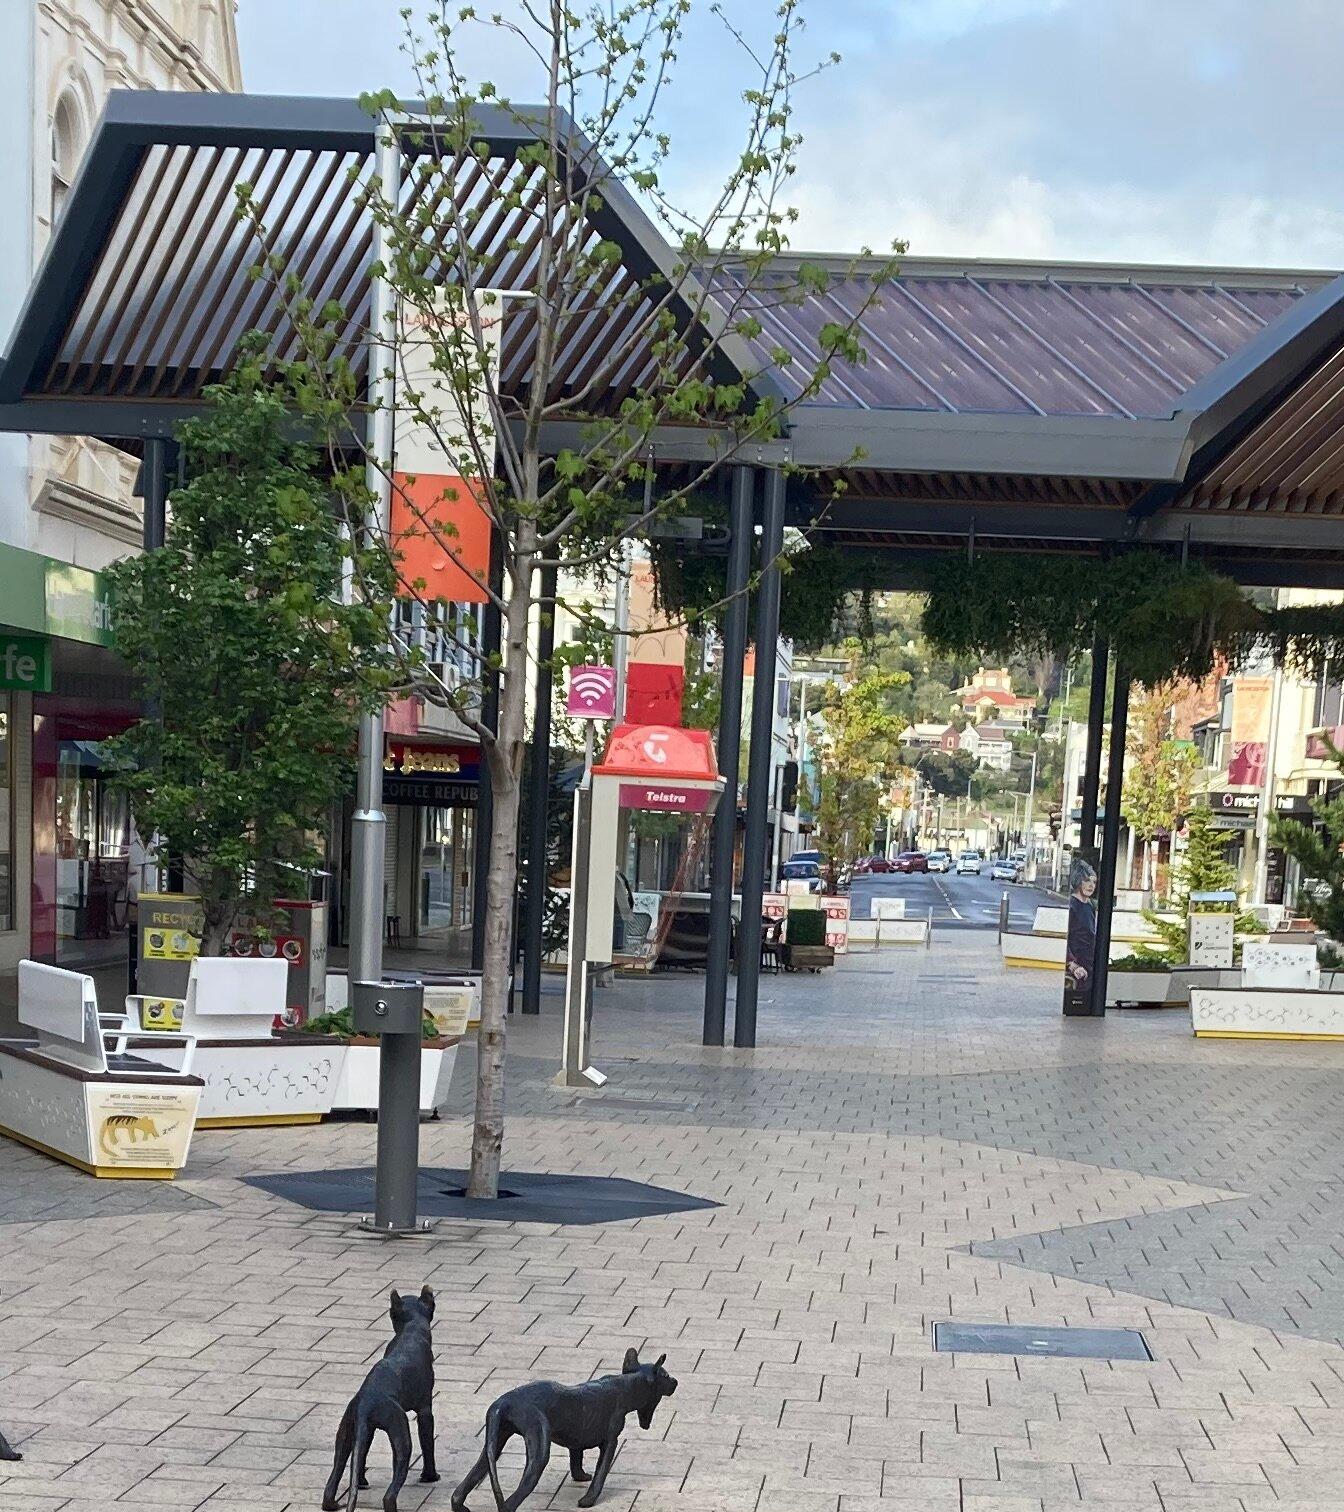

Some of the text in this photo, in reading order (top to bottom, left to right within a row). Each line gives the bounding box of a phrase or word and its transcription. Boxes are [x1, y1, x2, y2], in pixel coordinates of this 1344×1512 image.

[382, 783, 479, 801] COFFEE REPUB
[646, 791, 687, 804] Telstra
